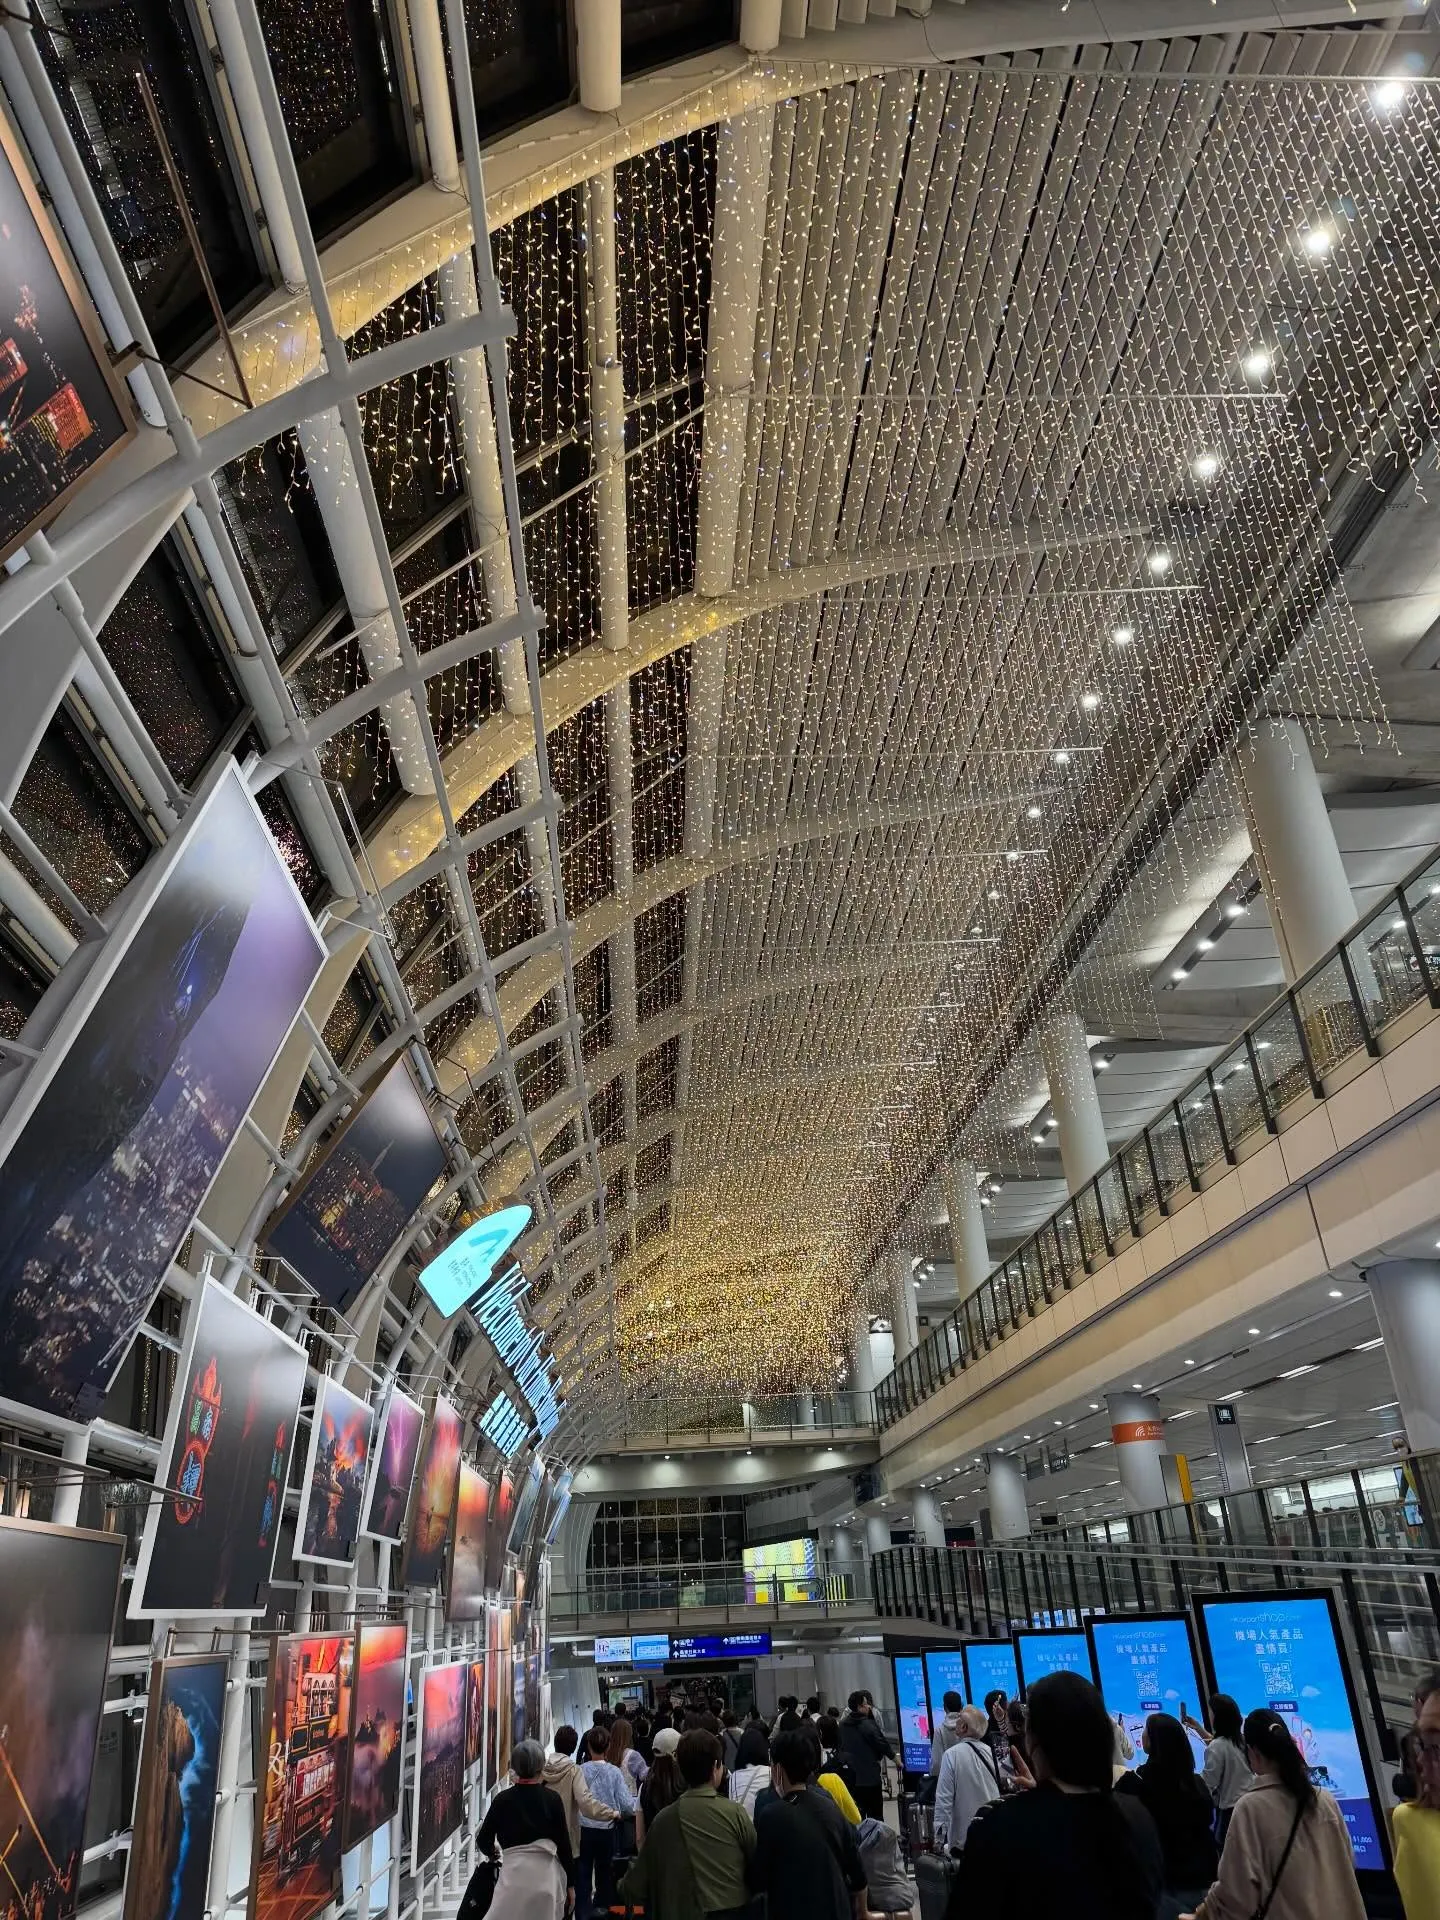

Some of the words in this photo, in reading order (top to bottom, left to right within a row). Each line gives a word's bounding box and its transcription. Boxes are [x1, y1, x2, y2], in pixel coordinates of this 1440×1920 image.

[470, 1260, 533, 1358] Welcome
[504, 1326, 537, 1367] to
[513, 1330, 546, 1387] Our
[1235, 1629, 1304, 1641] 機場人氣產品
